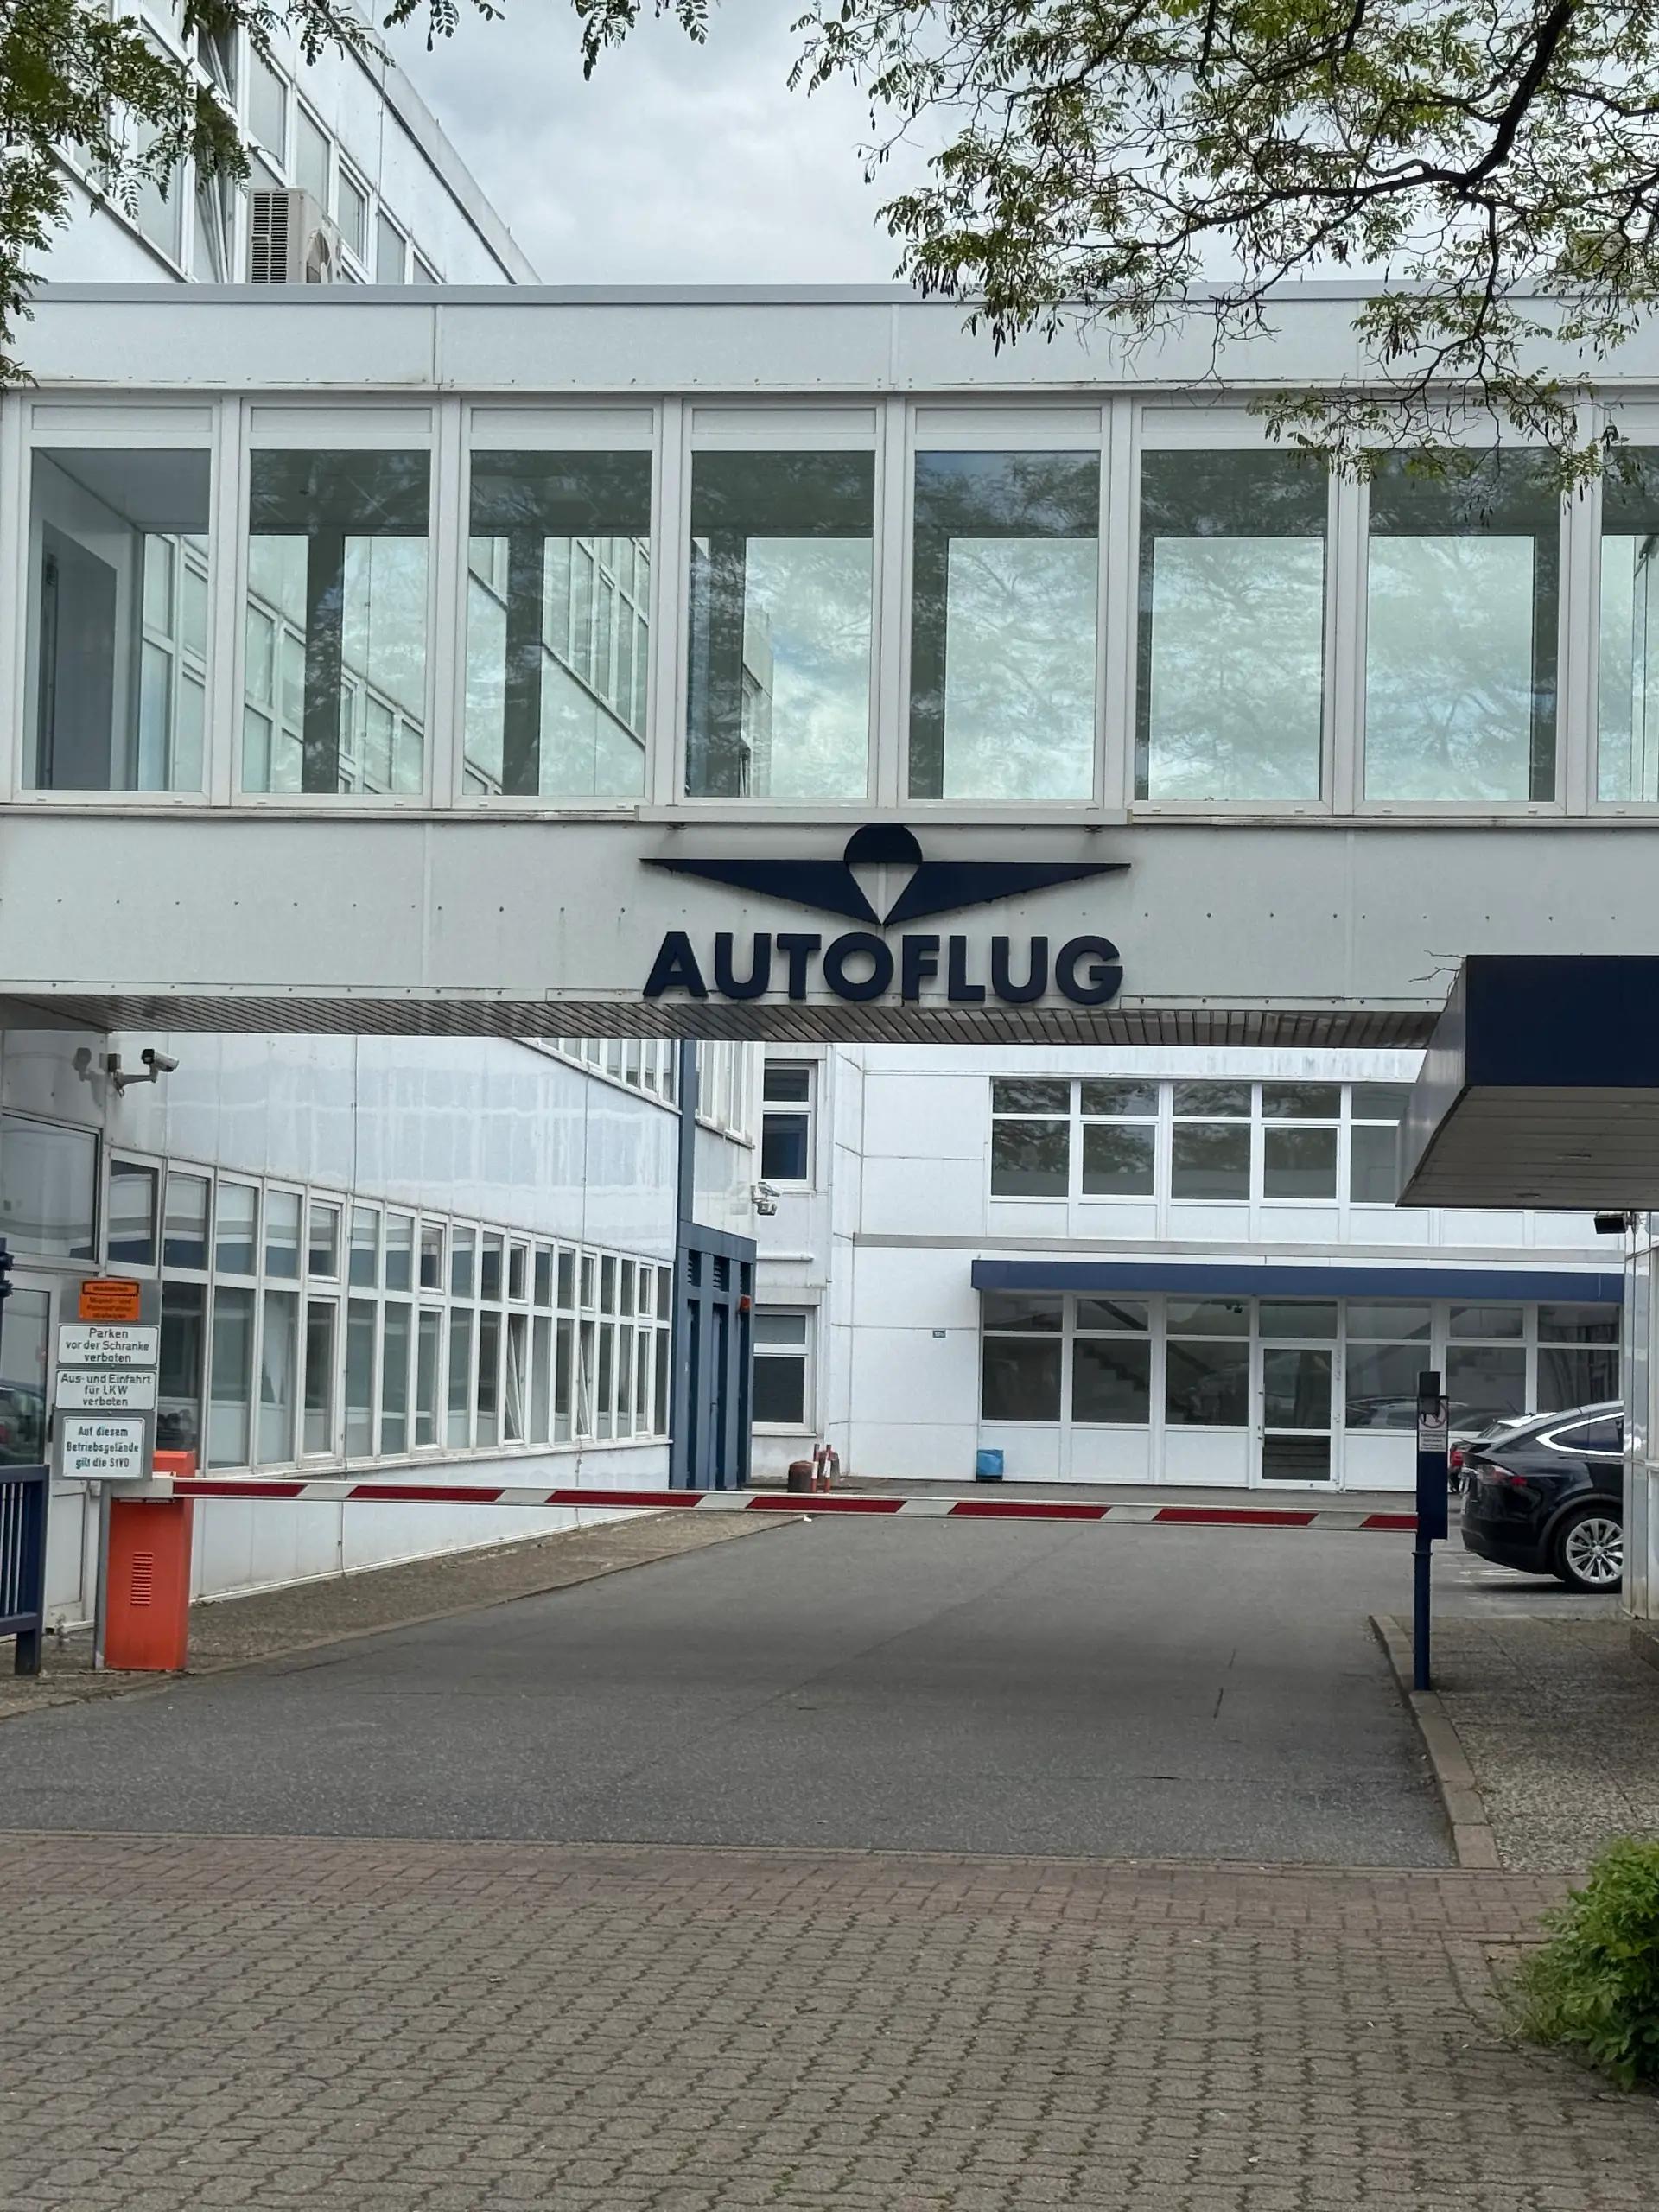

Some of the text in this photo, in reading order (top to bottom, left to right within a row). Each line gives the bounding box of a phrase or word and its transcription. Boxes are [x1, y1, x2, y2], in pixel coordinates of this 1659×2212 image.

[643, 931, 1123, 1006] AUTOFLUG
[89, 1327, 129, 1338] Parken
[66, 1340, 149, 1351] vor der Schranke
[84, 1352, 131, 1363] verboten
[60, 1373, 151, 1384] Aus- und Einfahrt
[85, 1385, 128, 1395] für LKW
[83, 1396, 129, 1406] verboten
[78, 1426, 129, 1436] Auf diesem
[66, 1441, 139, 1454] Betriebsgelände
[75, 1457, 130, 1470] gilt die StVO
